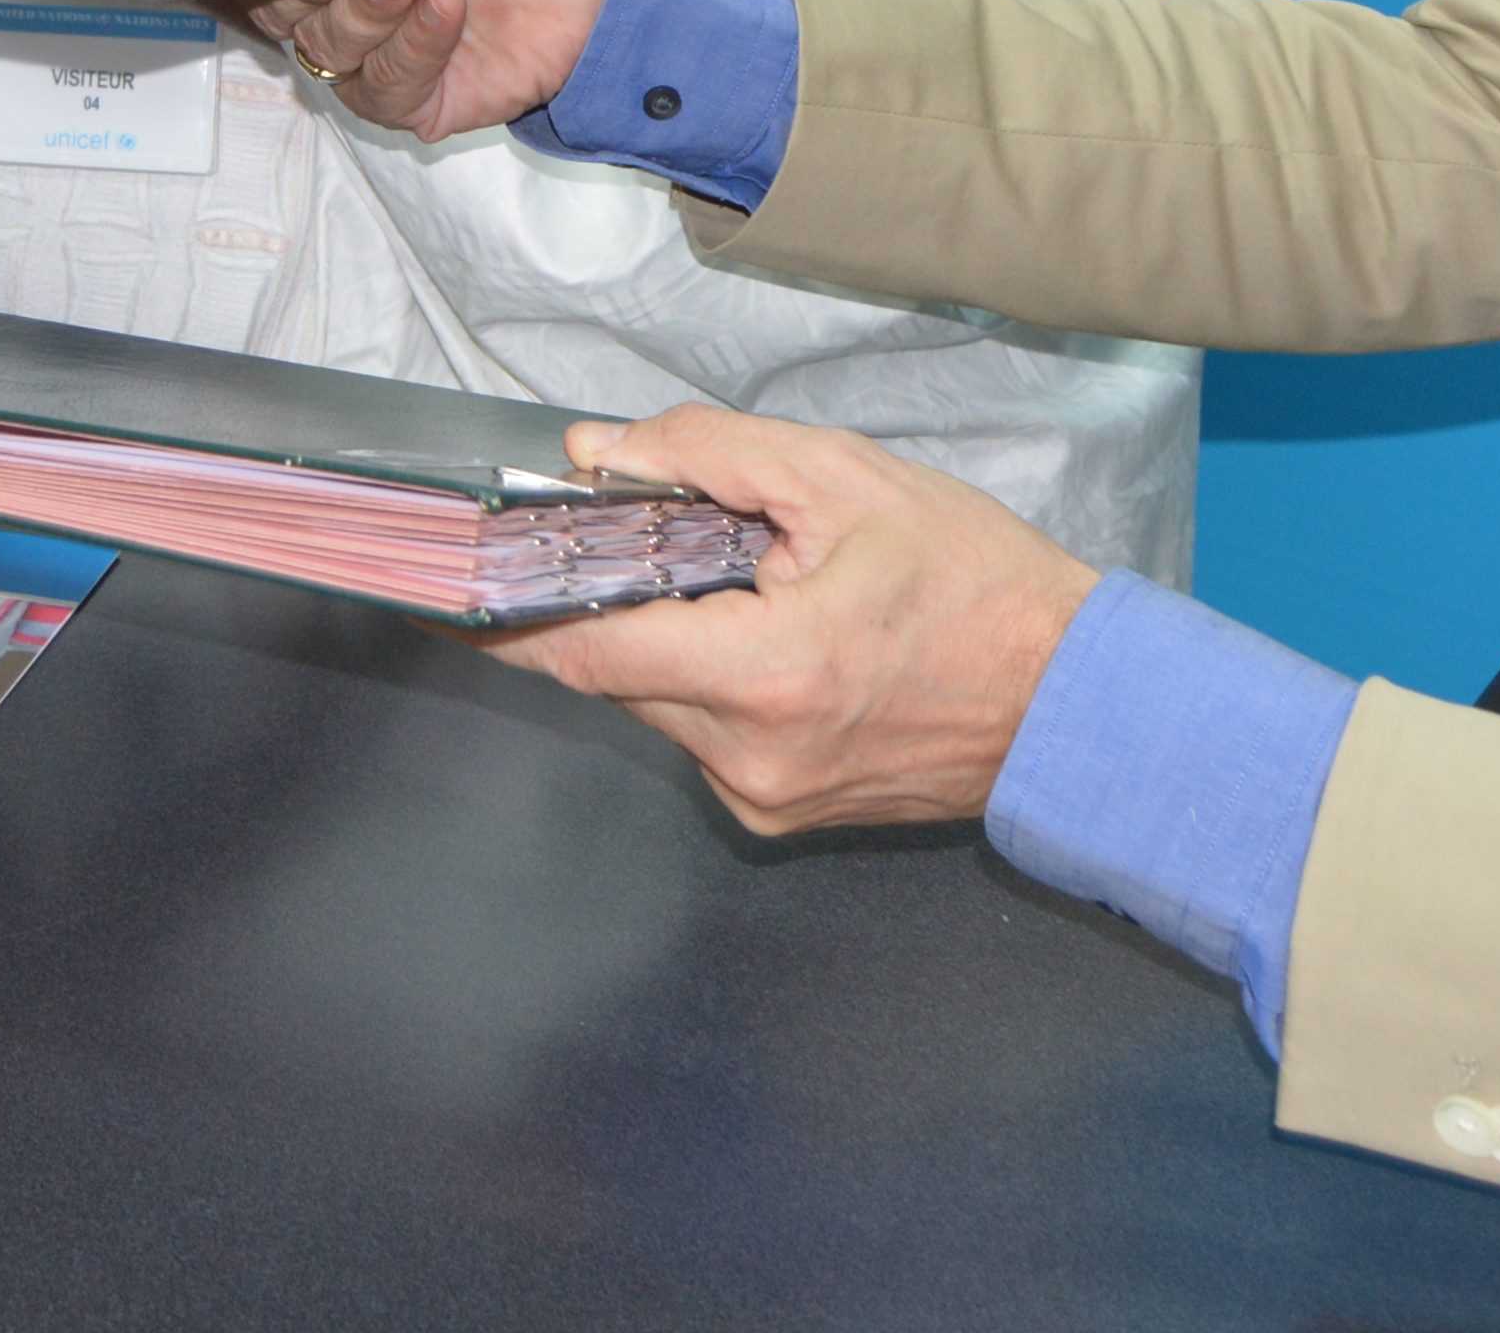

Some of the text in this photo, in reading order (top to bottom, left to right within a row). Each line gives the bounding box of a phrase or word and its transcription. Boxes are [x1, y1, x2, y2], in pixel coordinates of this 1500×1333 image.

[39, 10, 93, 24] NATIONS
[114, 14, 170, 29] NATIONS
[51, 67, 135, 90] VISITEUR
[83, 96, 100, 111] 04
[44, 129, 111, 151] unicef
